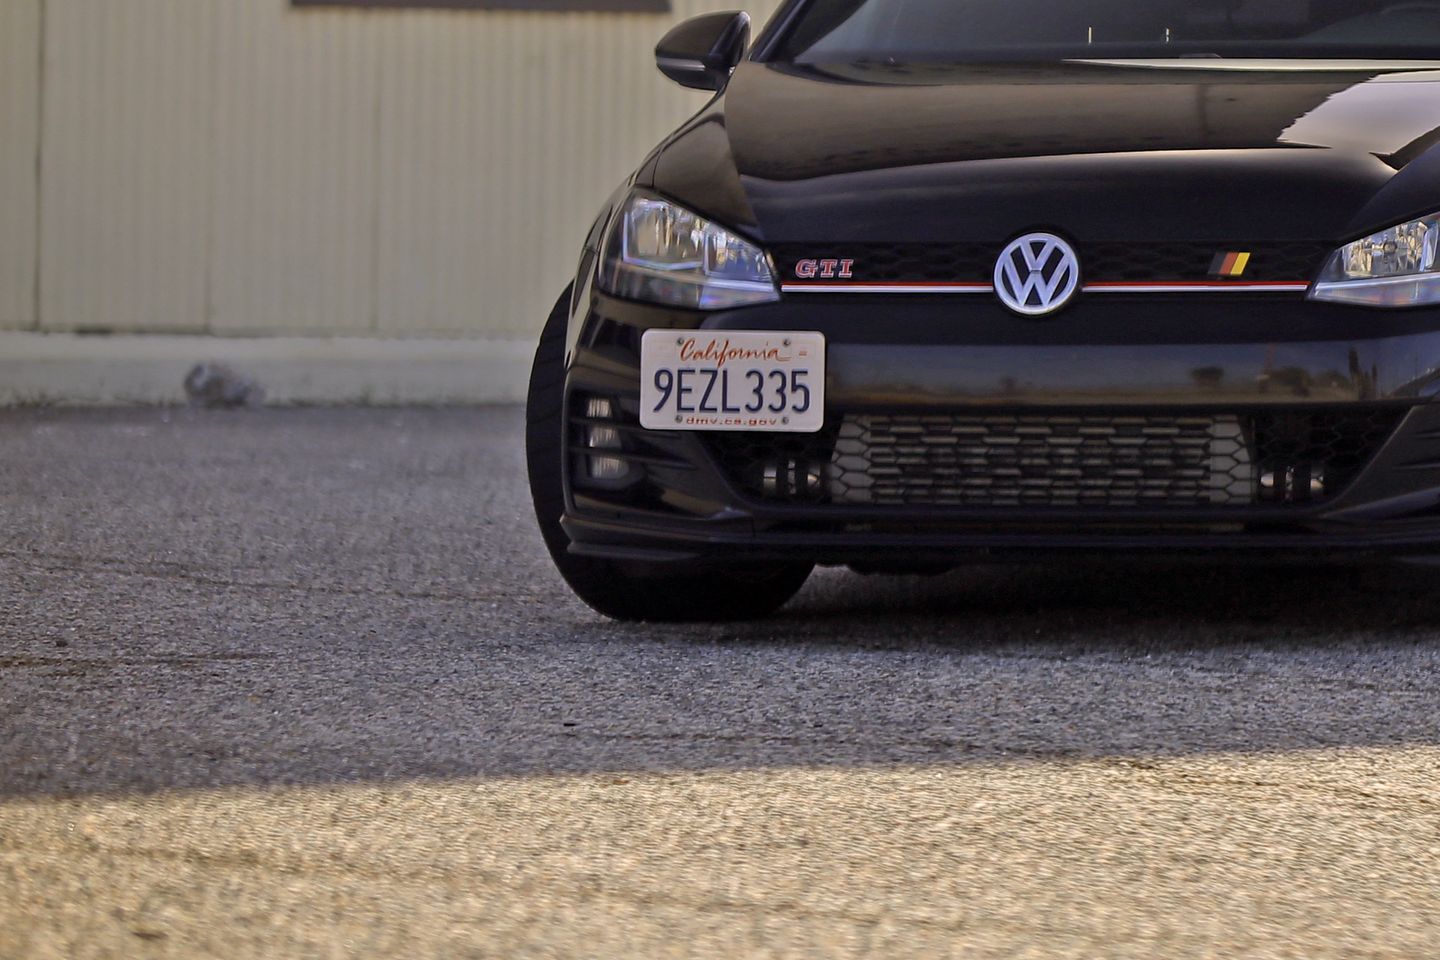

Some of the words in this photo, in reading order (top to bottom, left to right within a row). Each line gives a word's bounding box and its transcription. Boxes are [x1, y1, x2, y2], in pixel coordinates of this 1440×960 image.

[795, 258, 854, 278] GTI
[994, 233, 1078, 314] VW
[680, 339, 791, 367] California
[653, 368, 811, 414] 9EZL335
[686, 416, 778, 426] dmv.ca.gov
